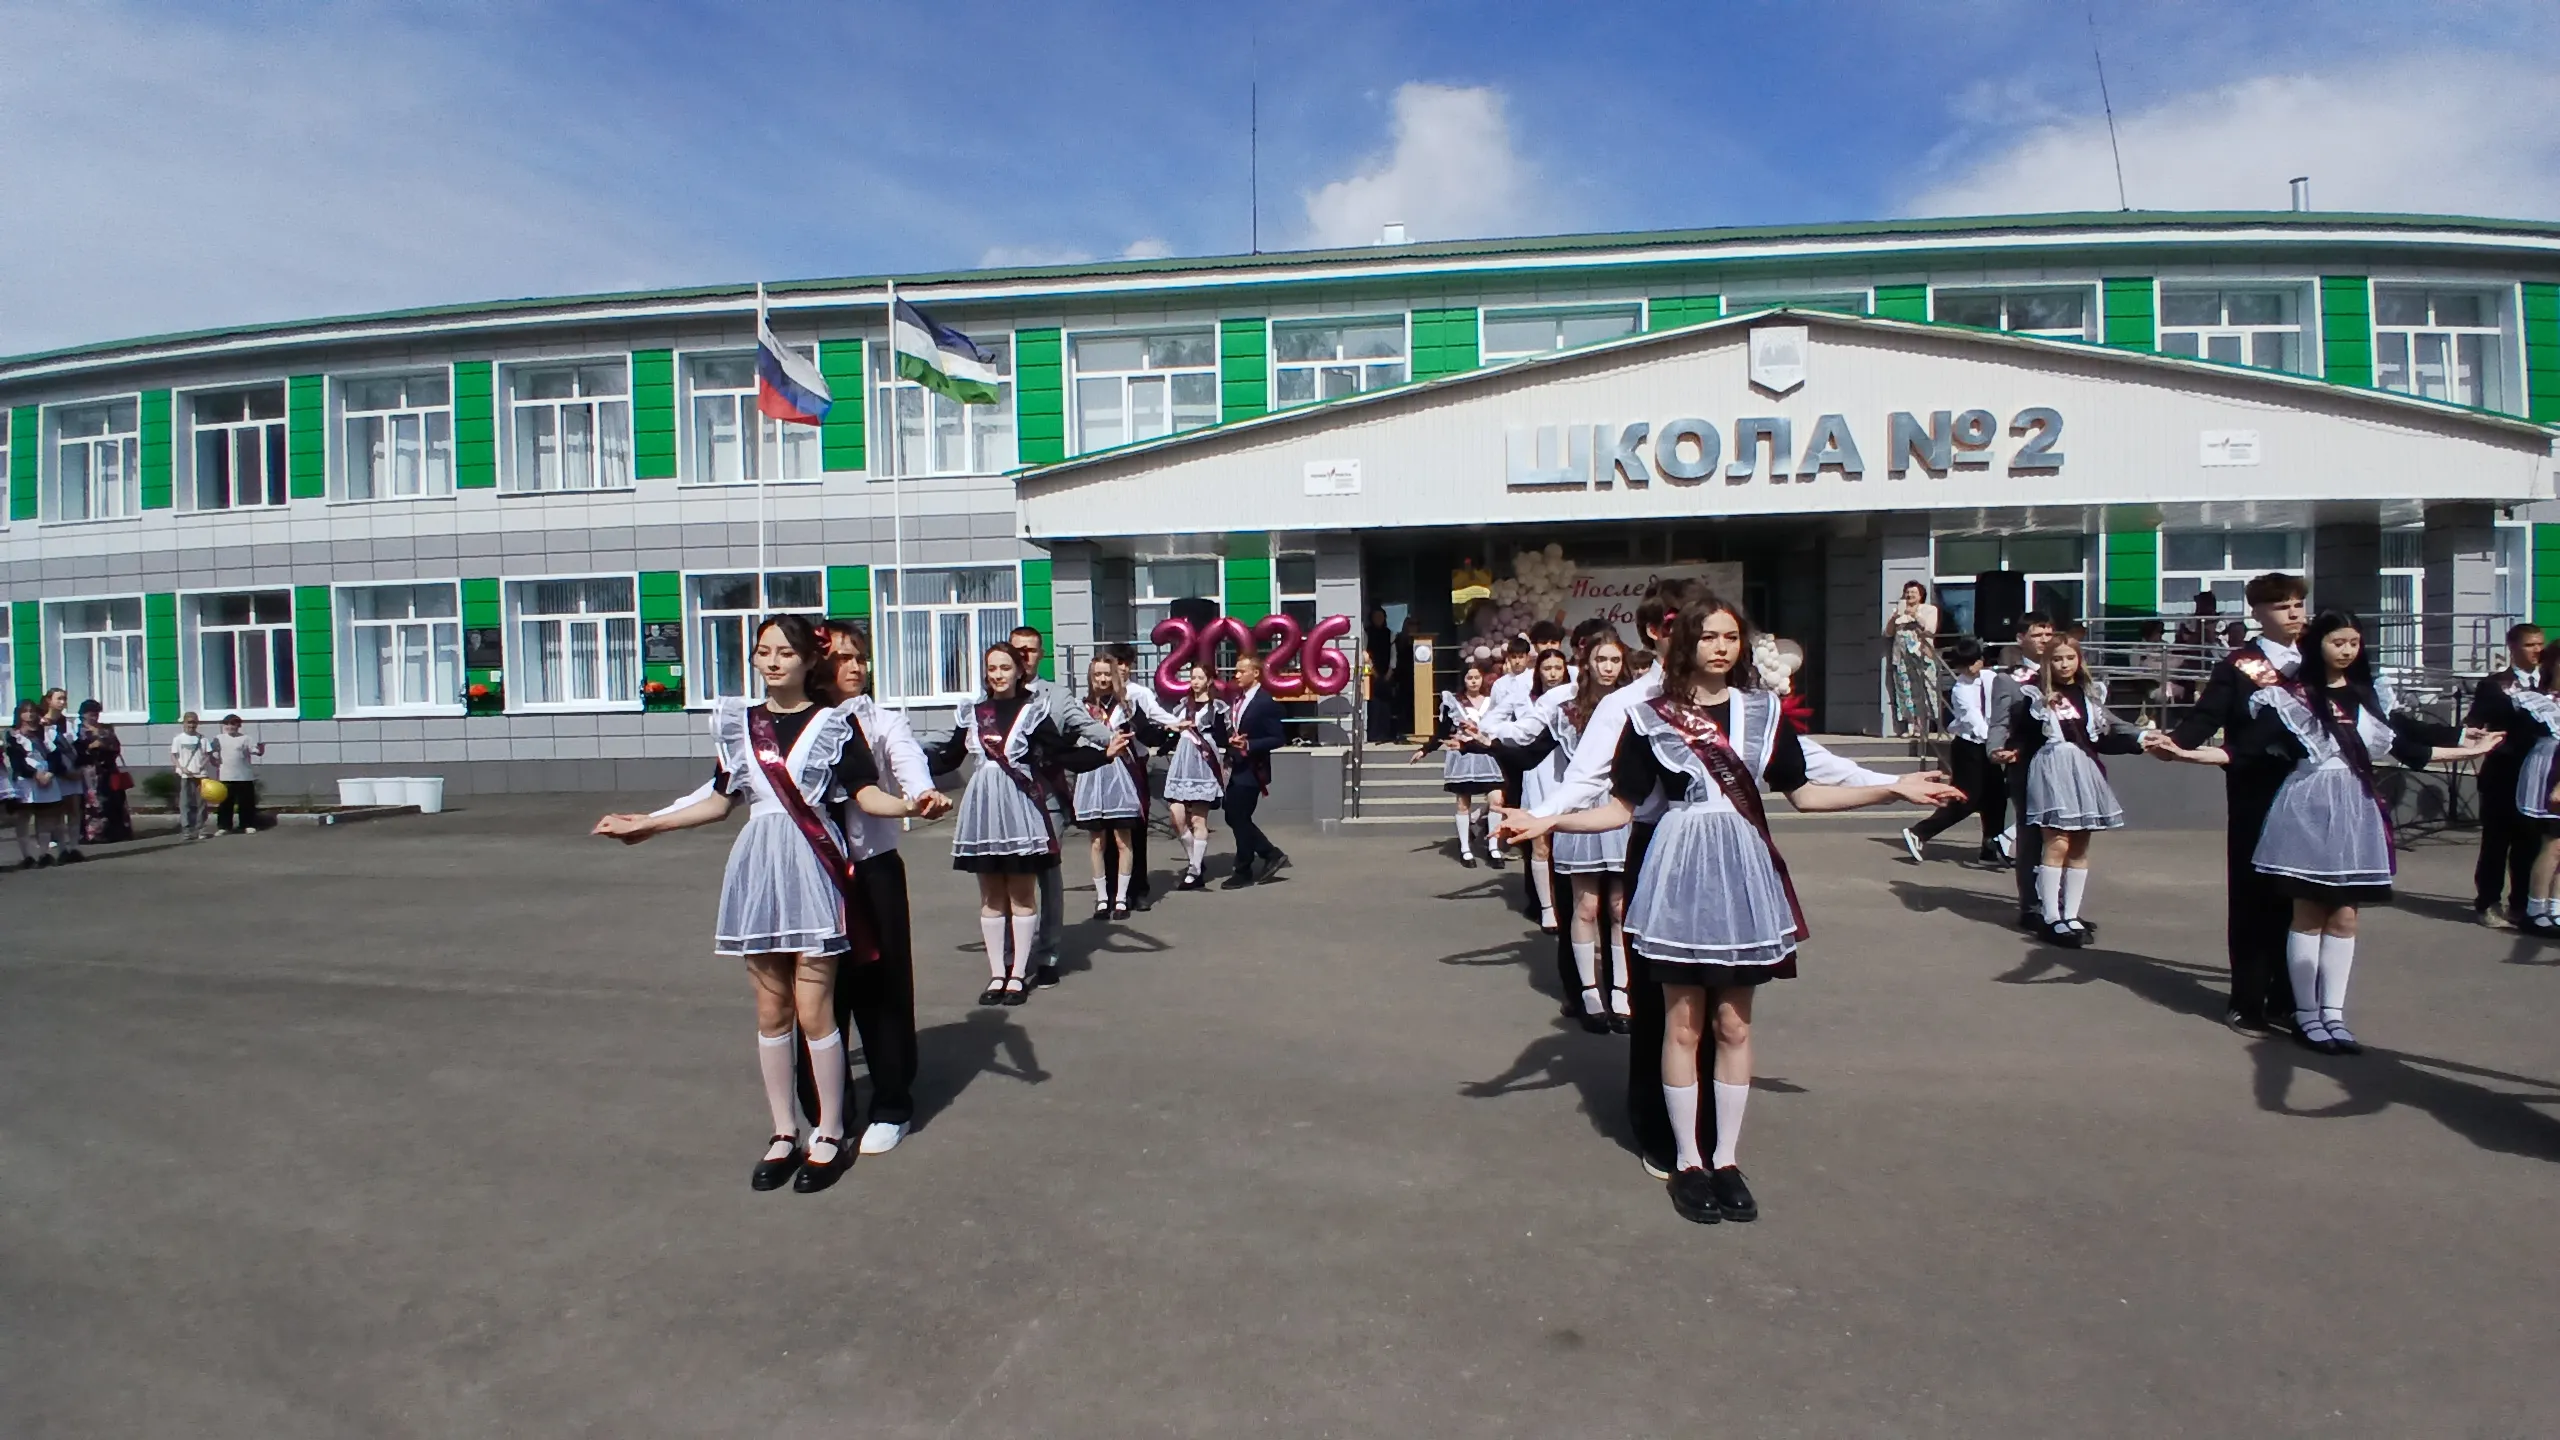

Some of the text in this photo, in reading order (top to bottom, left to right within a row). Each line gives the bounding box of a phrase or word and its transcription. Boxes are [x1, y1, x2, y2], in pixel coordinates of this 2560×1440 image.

[1506, 412, 1867, 491] ШКОЛА
[1594, 602, 1636, 624] зво
[1150, 613, 1351, 698] 2026
